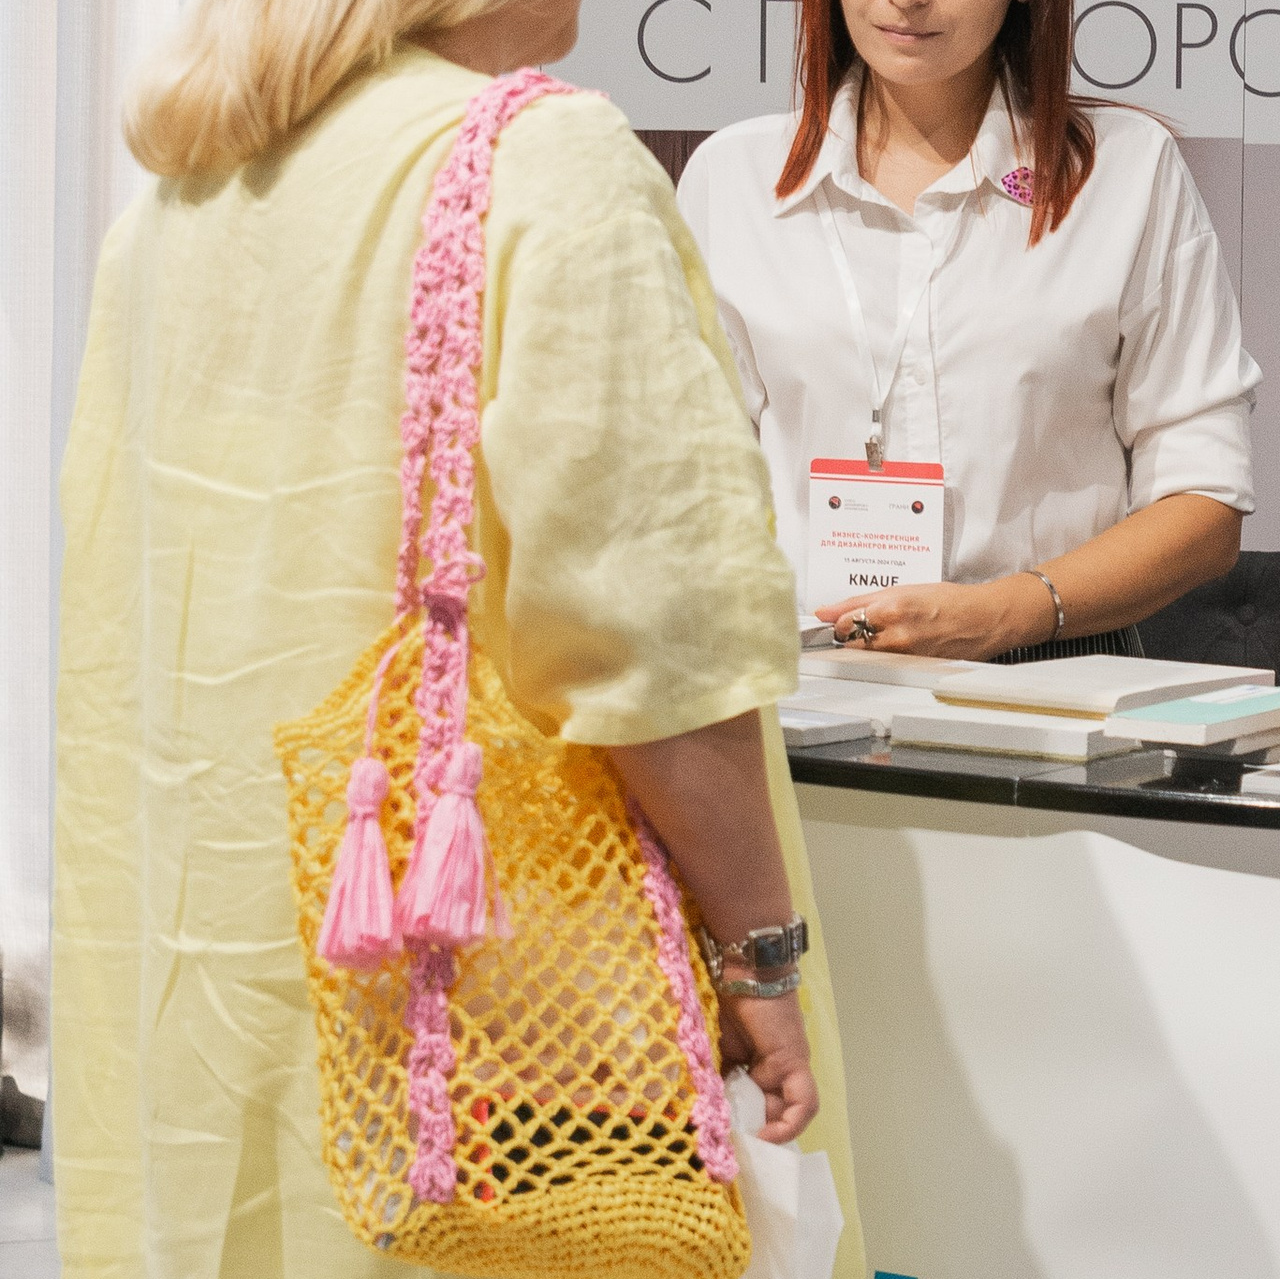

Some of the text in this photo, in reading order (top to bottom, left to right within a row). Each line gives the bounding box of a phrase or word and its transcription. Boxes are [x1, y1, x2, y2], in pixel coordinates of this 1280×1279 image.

[832, 531, 920, 542] БИЗНЕС-КОНФЕРЕНЦИЯ
[820, 540, 931, 553] ДЛЯ ДИЗАЙНЕРОВ ИНТЕРЬЕРА
[849, 573, 899, 588] KNAUF
